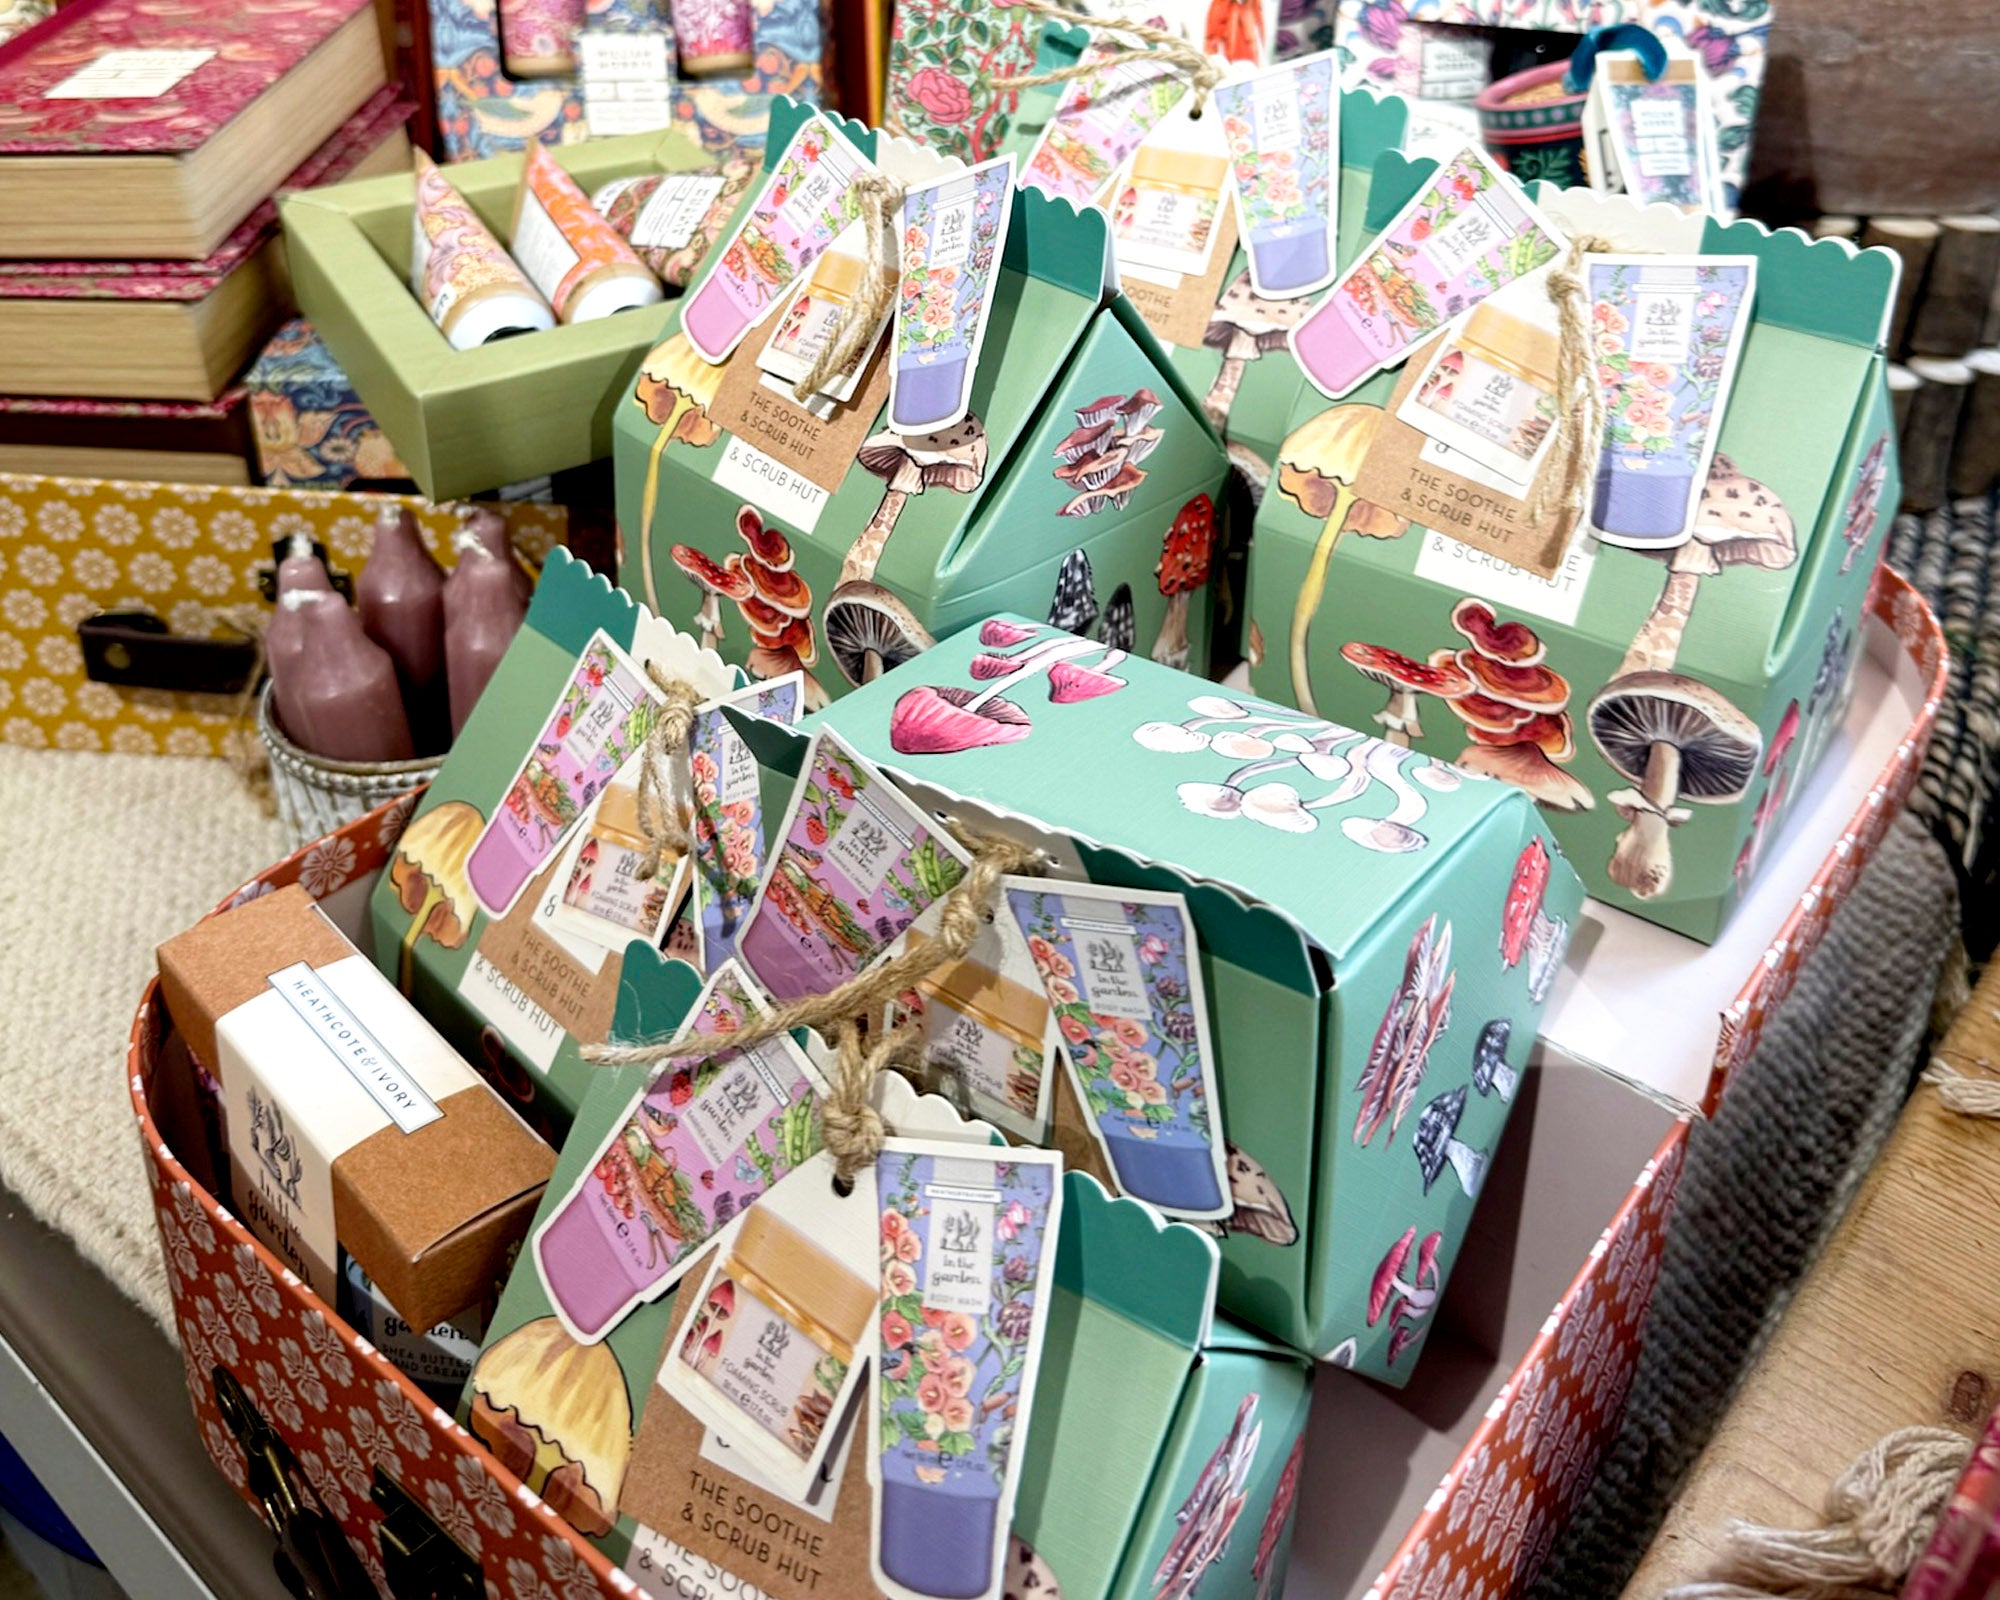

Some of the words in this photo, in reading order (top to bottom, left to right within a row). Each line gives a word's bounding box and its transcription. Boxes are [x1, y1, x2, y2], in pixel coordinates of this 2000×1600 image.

[1122, 284, 1173, 308] OOTHE
[740, 410, 749, 423] &
[750, 416, 790, 446] SCRUB
[790, 440, 816, 460] HUT
[749, 391, 772, 413] THE
[772, 404, 822, 442] SOOTHE
[729, 446, 740, 461] &
[742, 453, 788, 487] SCRUB
[789, 478, 822, 504] HUT
[1410, 467, 1442, 490] THE
[1444, 484, 1517, 524] SOOTHE
[1400, 488, 1412, 502] &
[1416, 494, 1473, 528] SCRUB
[1477, 522, 1514, 544] HUT
[1432, 536, 1444, 554] &
[511, 951, 518, 966] &
[520, 958, 559, 998] SCRUB
[558, 992, 585, 1020] HUT
[522, 930, 544, 956] THE
[544, 950, 591, 998] SOOTHE
[1098, 974, 1110, 985] in
[1111, 974, 1130, 986] the
[486, 966, 529, 1012] SCRUB
[528, 1004, 561, 1039] HUT
[1091, 986, 1139, 998] garden
[700, 1099, 732, 1143] garden
[716, 1096, 724, 1111] in
[932, 1270, 983, 1288] garden
[943, 1255, 956, 1268] in
[956, 1256, 975, 1270] the
[381, 1344, 414, 1360] SHEA
[420, 1352, 473, 1368] BUTTER
[424, 1365, 471, 1378] CREAM
[743, 1358, 776, 1386] garden
[721, 1358, 760, 1395] FOAMING
[759, 1389, 788, 1418] SCRUB
[689, 1470, 730, 1506] THE
[734, 1495, 824, 1557] SOOTHE
[638, 1547, 654, 1572] &
[680, 1502, 694, 1523] &
[701, 1513, 772, 1564] SCRUB
[776, 1553, 823, 1591] HUT
